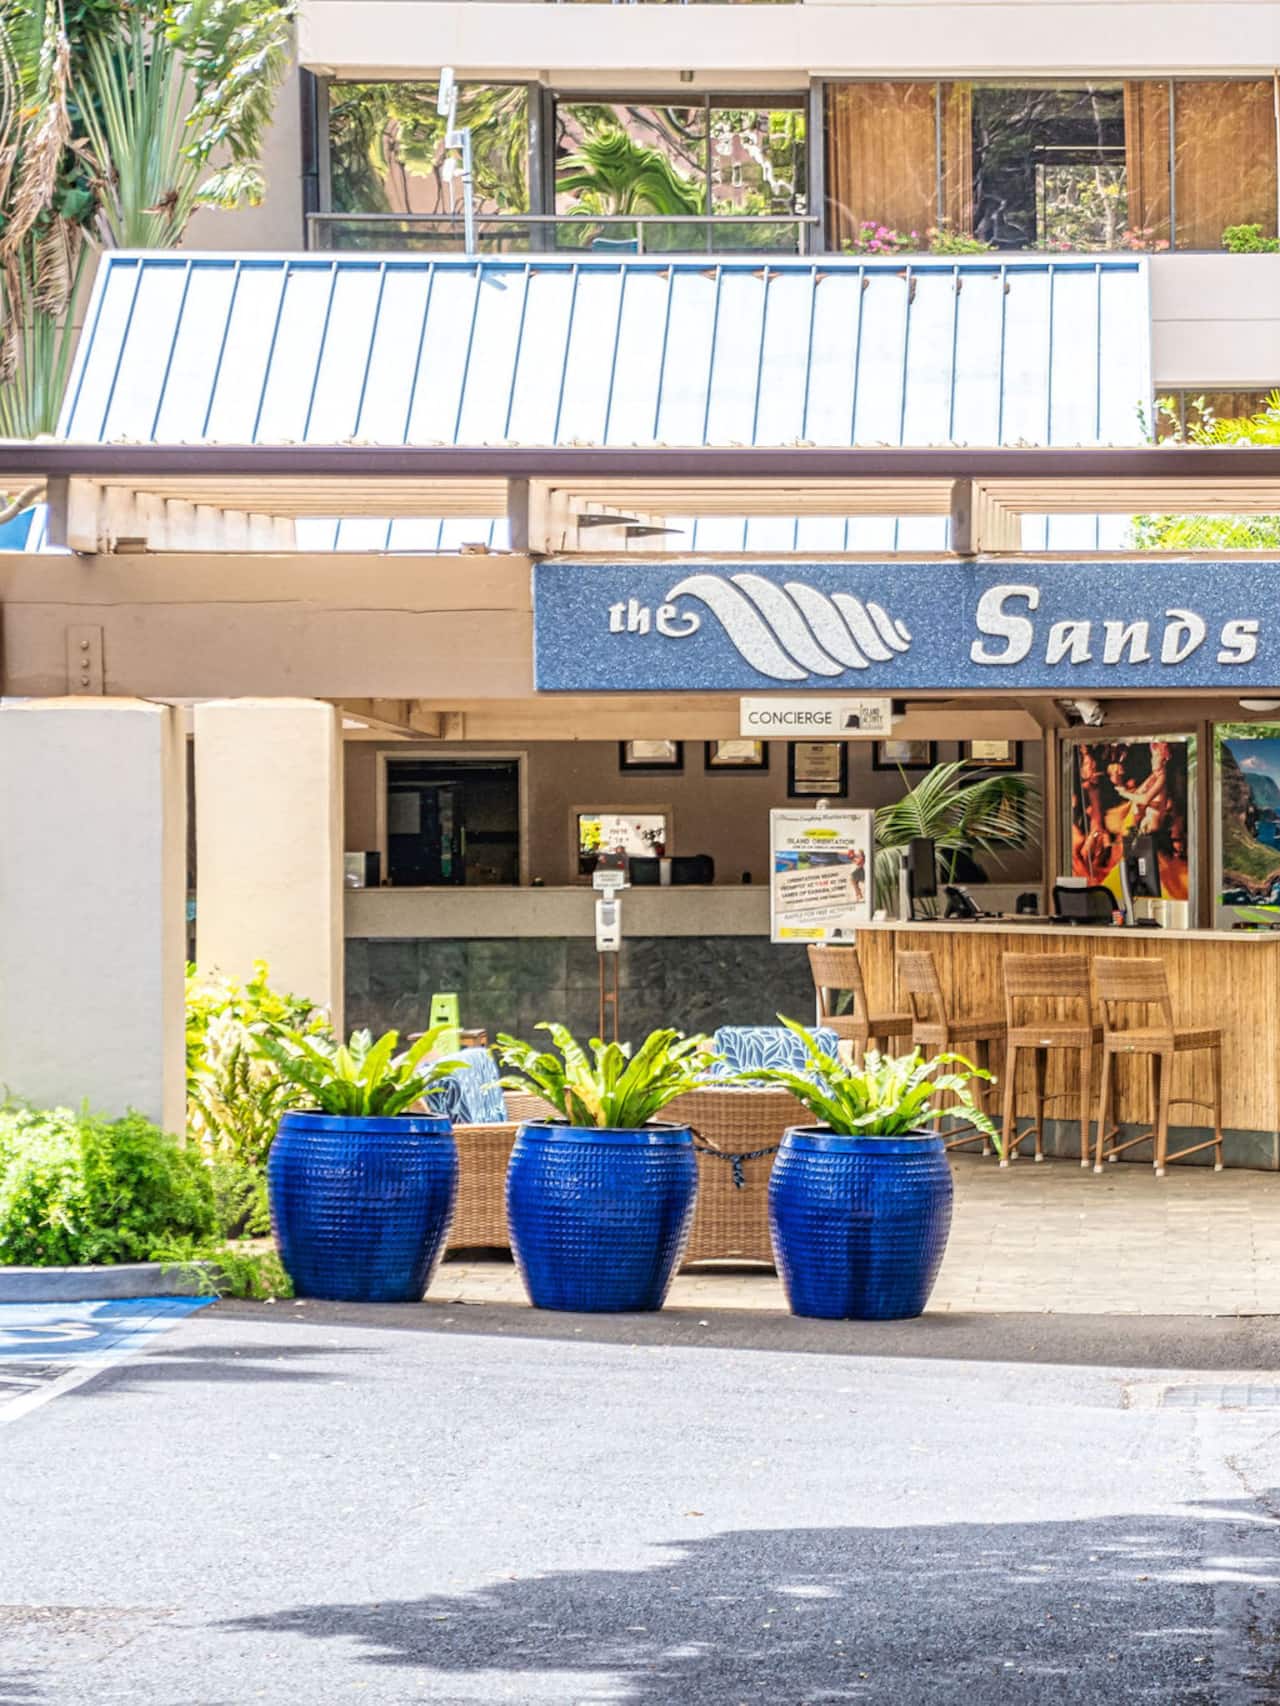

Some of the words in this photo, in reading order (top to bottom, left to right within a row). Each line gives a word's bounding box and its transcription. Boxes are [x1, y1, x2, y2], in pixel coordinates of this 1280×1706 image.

[608, 598, 700, 637] the
[970, 584, 1260, 665] Sands
[748, 711, 832, 725] CONCIERGE
